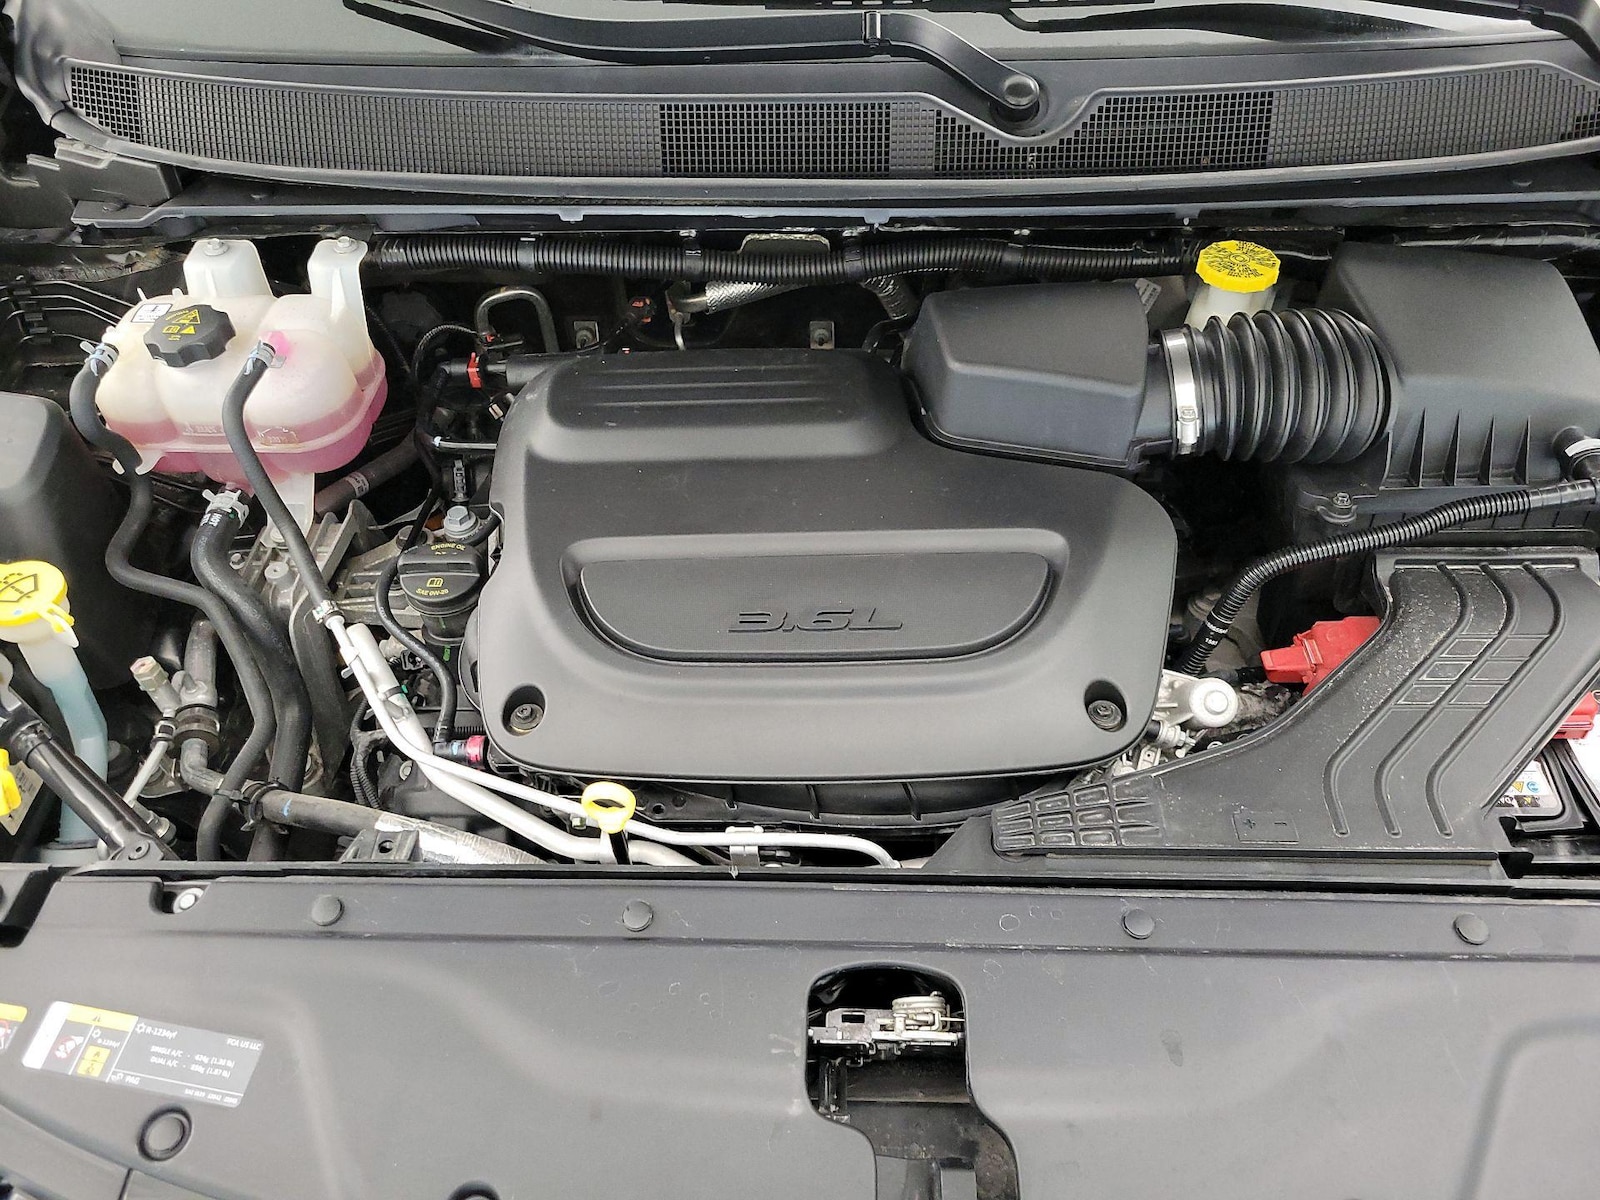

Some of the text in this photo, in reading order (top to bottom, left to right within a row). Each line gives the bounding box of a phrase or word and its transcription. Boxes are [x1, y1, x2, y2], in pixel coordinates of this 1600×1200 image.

[431, 542, 456, 551] ENGINE
[416, 588, 429, 596] SAE
[728, 607, 903, 633] 3.6L
[145, 1027, 178, 1040] R-1234yf
[227, 1038, 262, 1051] FCA US LLC
[172, 1048, 183, 1057] A/C
[150, 1056, 166, 1065] DUAL
[167, 1058, 179, 1067] A/C
[125, 1075, 140, 1085] PAG
